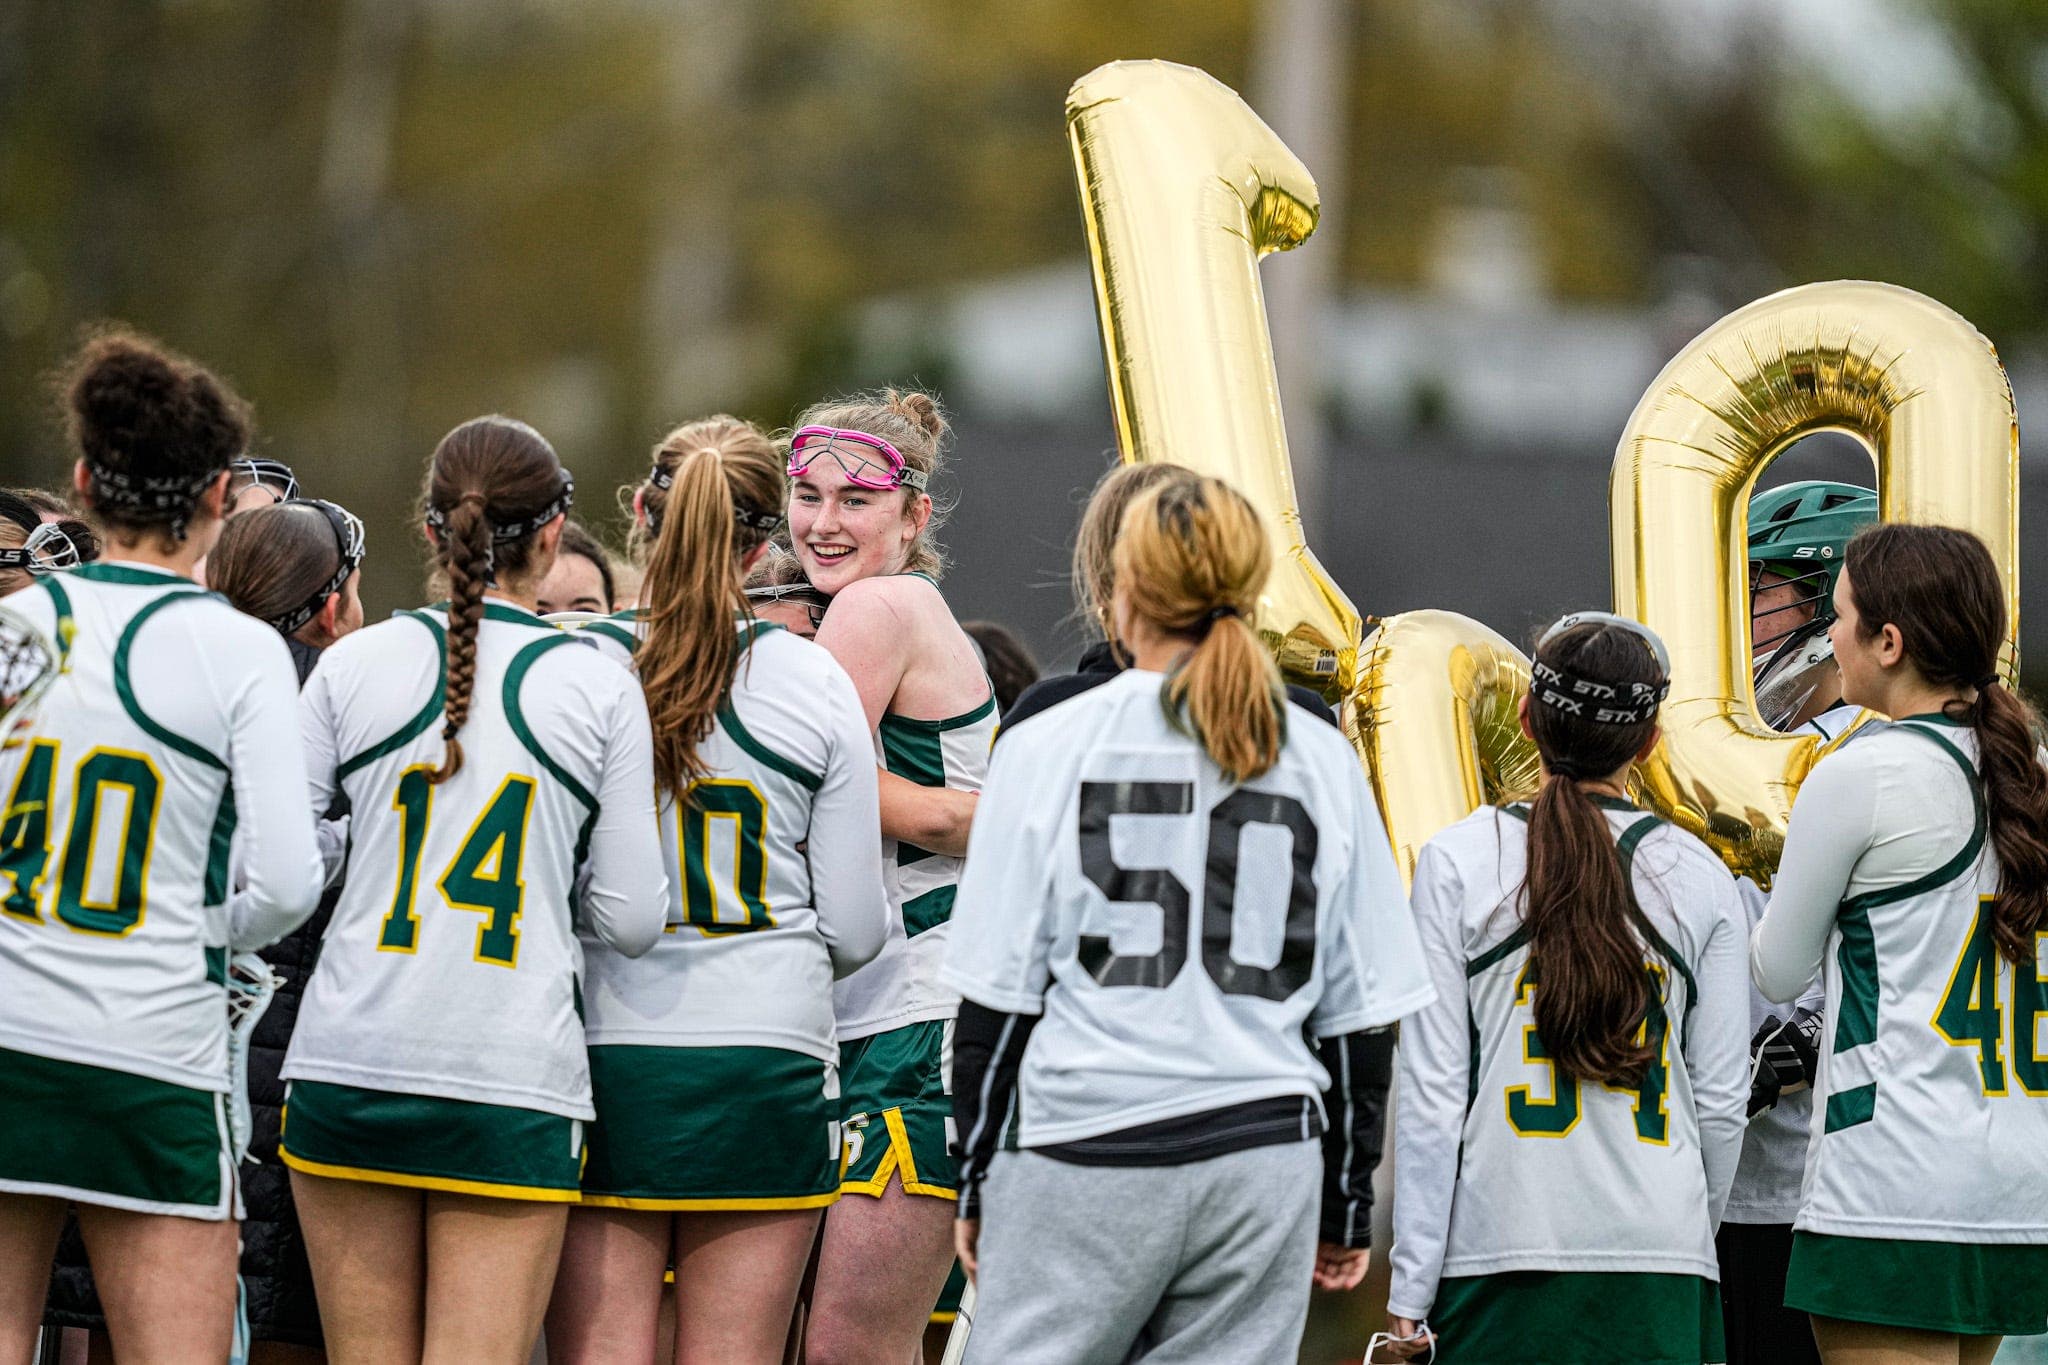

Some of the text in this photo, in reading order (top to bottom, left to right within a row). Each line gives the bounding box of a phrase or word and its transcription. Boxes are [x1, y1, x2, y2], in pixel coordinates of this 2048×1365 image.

[1534, 662, 1563, 686] STX
[1541, 689, 1583, 716] STX
[1573, 679, 1616, 699] STX
[1595, 708, 1638, 723] STX
[0, 737, 165, 939] 40
[376, 763, 538, 970] 14
[653, 777, 778, 938] 0
[1078, 781, 1319, 1003] 50
[1504, 956, 1672, 1147] 34
